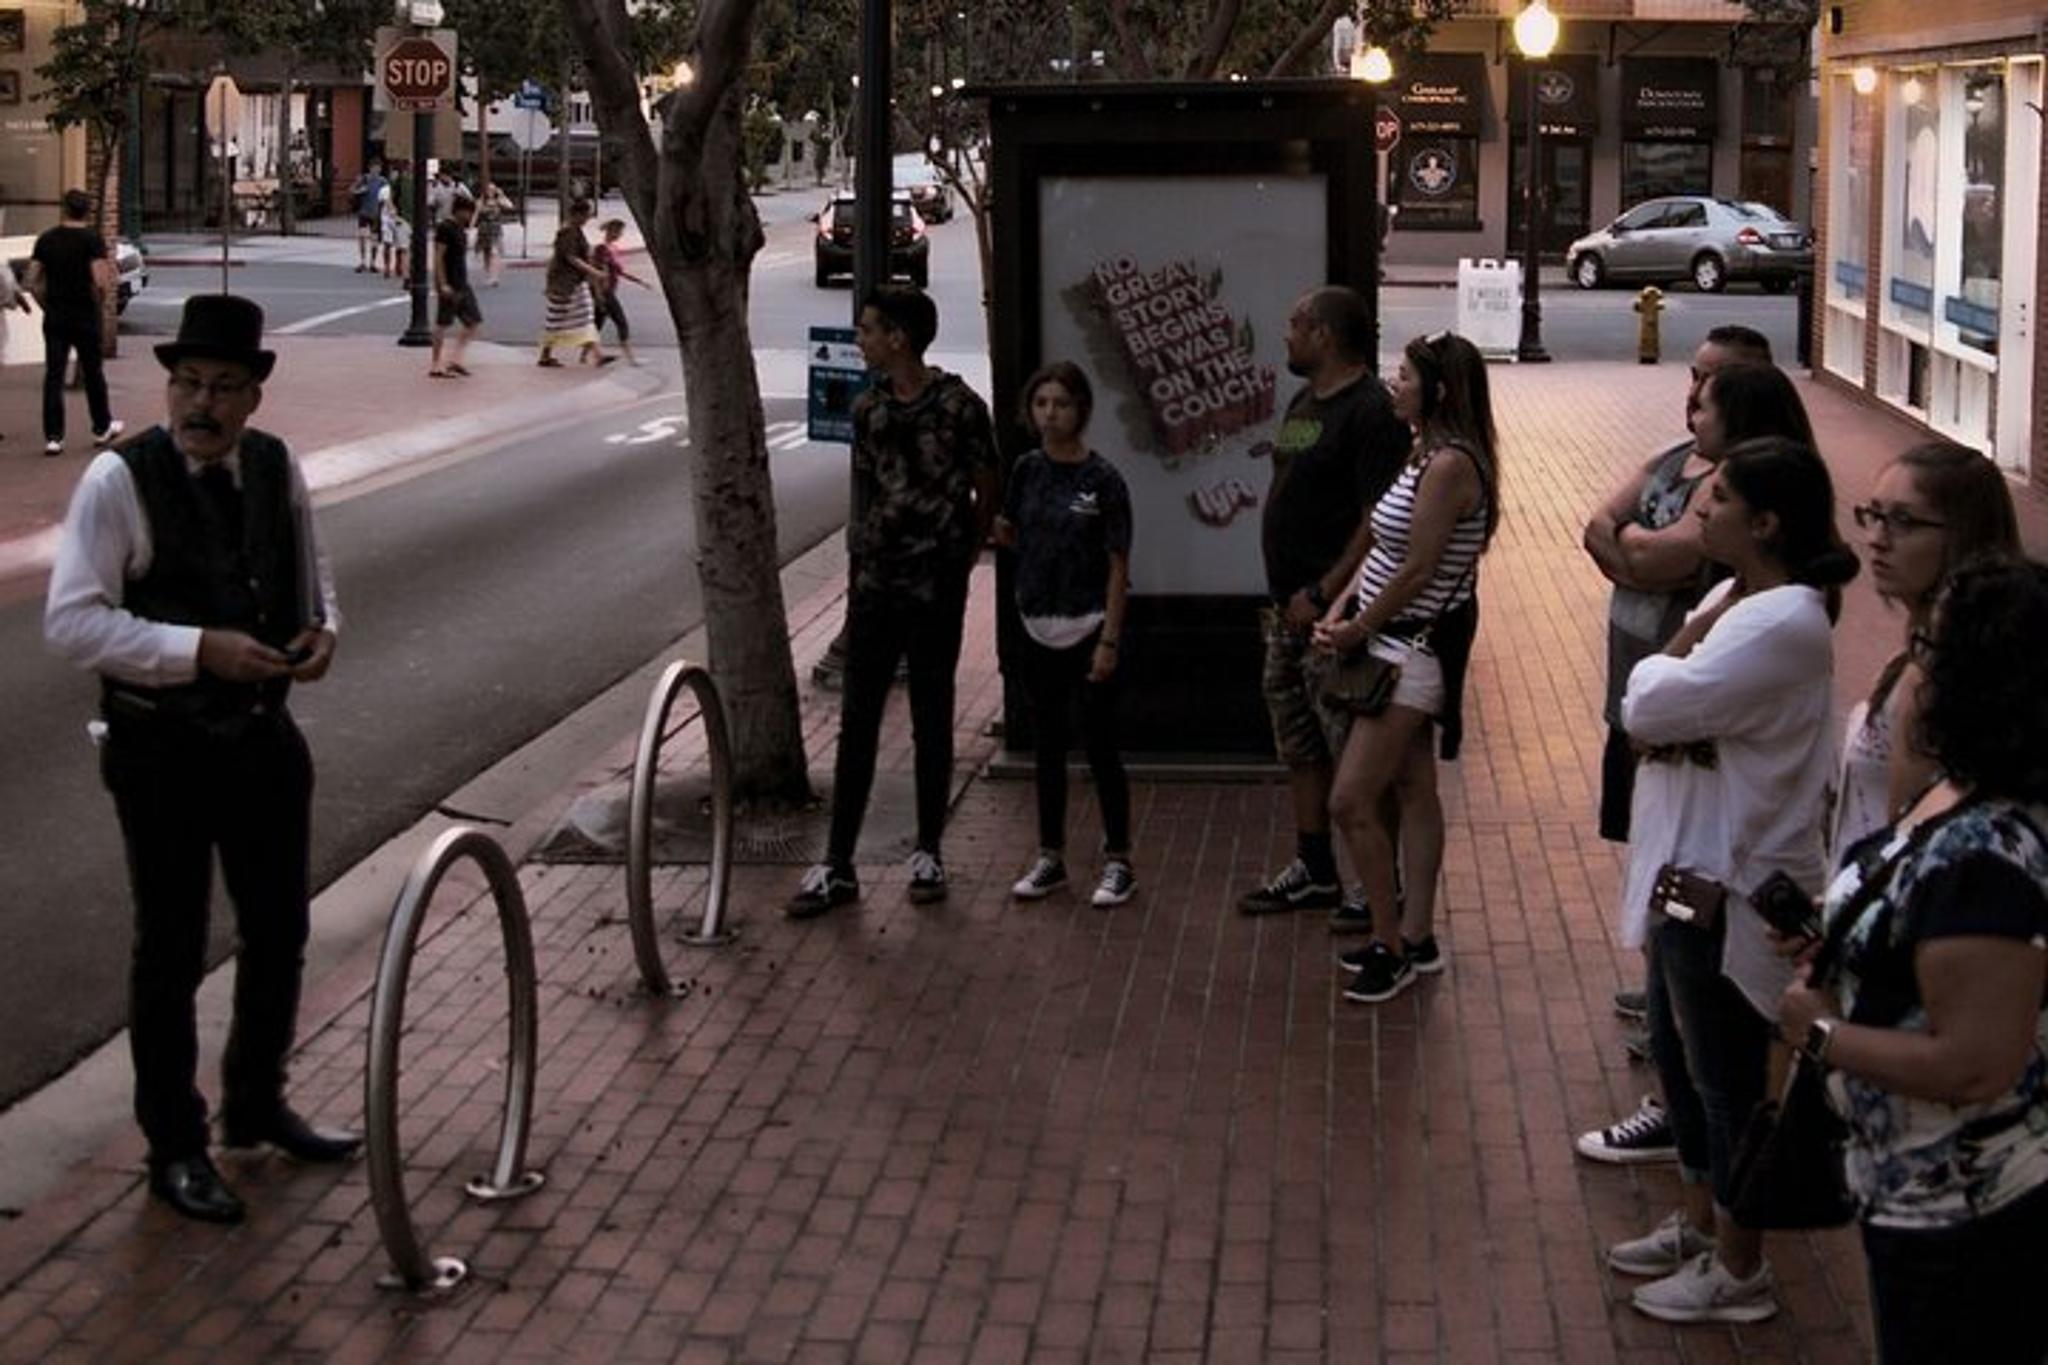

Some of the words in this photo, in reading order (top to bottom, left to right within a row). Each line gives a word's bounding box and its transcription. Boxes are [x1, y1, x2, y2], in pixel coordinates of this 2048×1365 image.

[389, 59, 448, 86] STOP
[1377, 121, 1398, 138] OP
[1095, 253, 1136, 285] NO
[1107, 258, 1199, 305] GREAT
[1118, 280, 1204, 330] STORY
[1126, 302, 1228, 357] BEGINS
[1169, 327, 1231, 367] WAS
[1151, 368, 1197, 400] ON
[1199, 347, 1252, 383] THE
